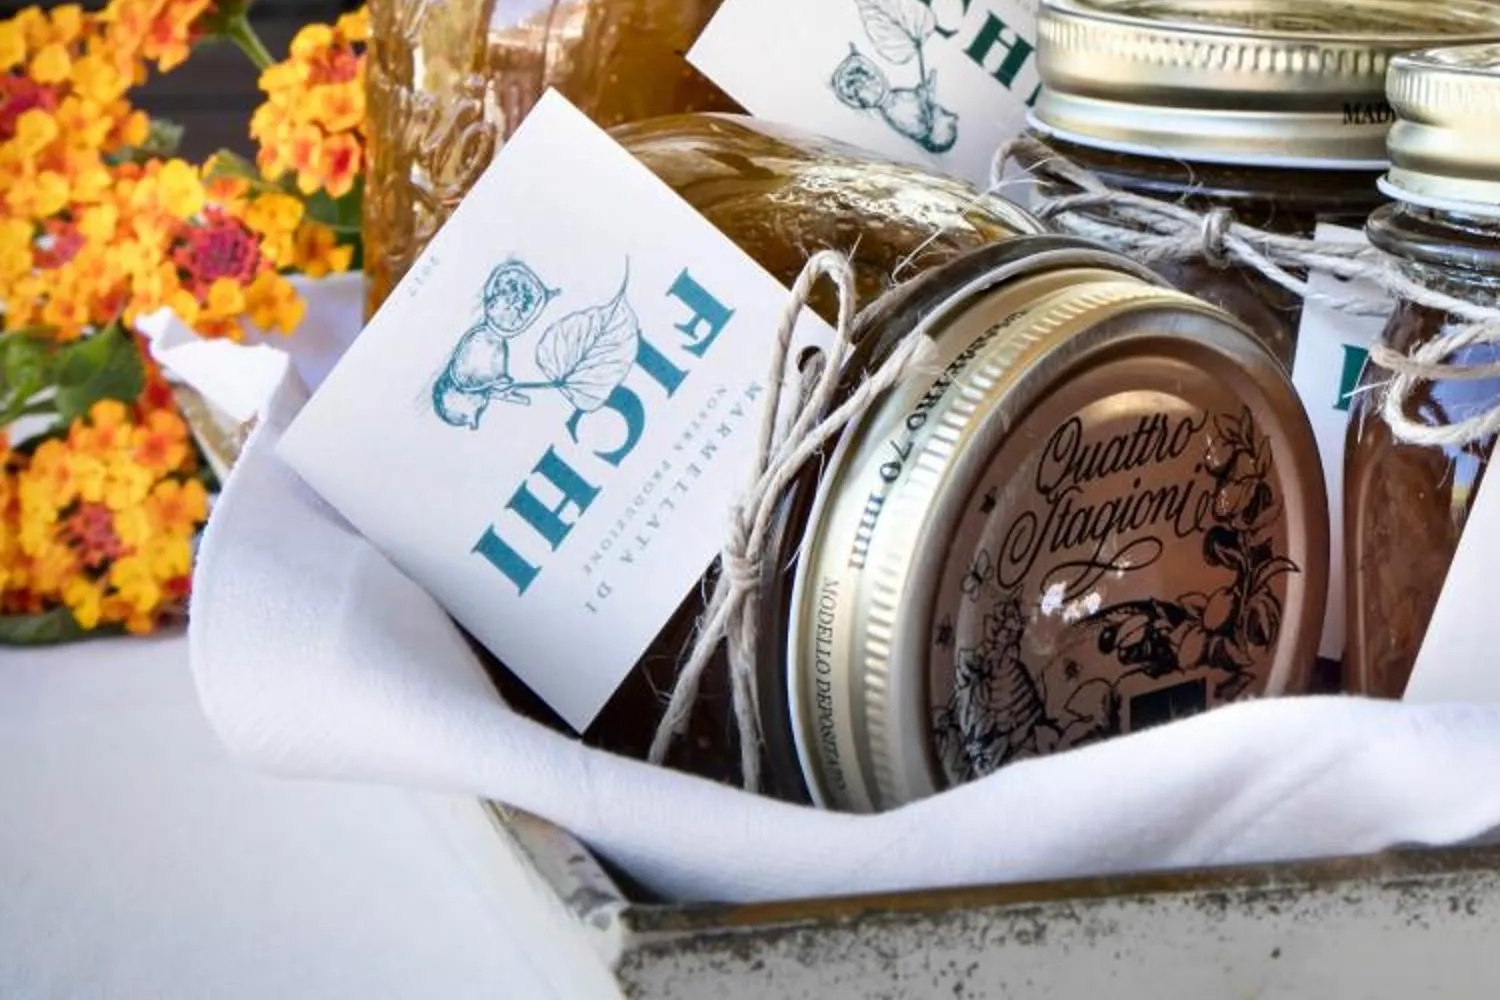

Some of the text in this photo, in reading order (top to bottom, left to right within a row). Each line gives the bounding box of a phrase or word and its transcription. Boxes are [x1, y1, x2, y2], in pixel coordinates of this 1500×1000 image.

[1342, 102, 1397, 125] MAD
[469, 267, 736, 597] FICHI
[1036, 410, 1208, 502] Quattro
[584, 380, 763, 615] MARMELLATA DI
[997, 463, 1214, 597] Stagioni
[816, 577, 840, 676] MODELLO
